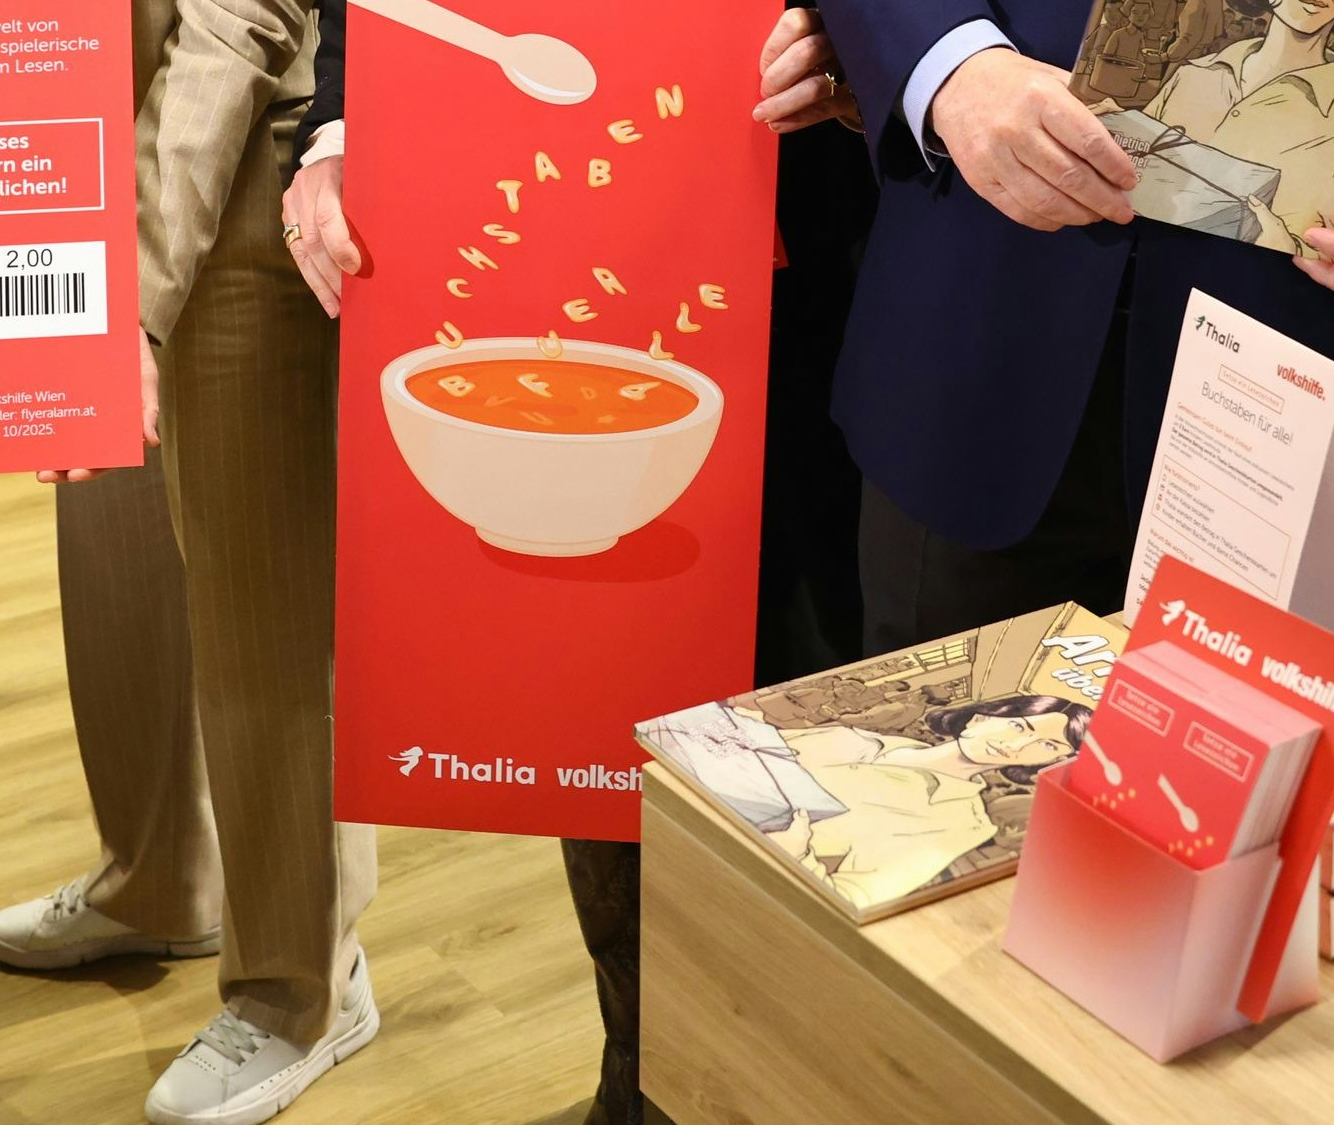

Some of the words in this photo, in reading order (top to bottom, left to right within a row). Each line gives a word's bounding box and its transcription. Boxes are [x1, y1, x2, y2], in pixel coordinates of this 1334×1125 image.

[28, 19, 59, 32] von
[0, 36, 99, 56] spielerische
[15, 57, 69, 73] Lesen.
[21, 156, 52, 172] ein
[6, 248, 53, 270] 2,00
[1205, 321, 1241, 354] Thalia
[1276, 364, 1326, 401] volkshilfe.
[35, 390, 66, 403] Wien
[21, 405, 97, 421] flyeralarm.at,
[1201, 381, 1256, 425] Buchstaben
[1258, 414, 1273, 433] für
[3, 423, 56, 437] 10/2025.
[1181, 611, 1253, 666] Thalia
[428, 753, 535, 784] Thalia
